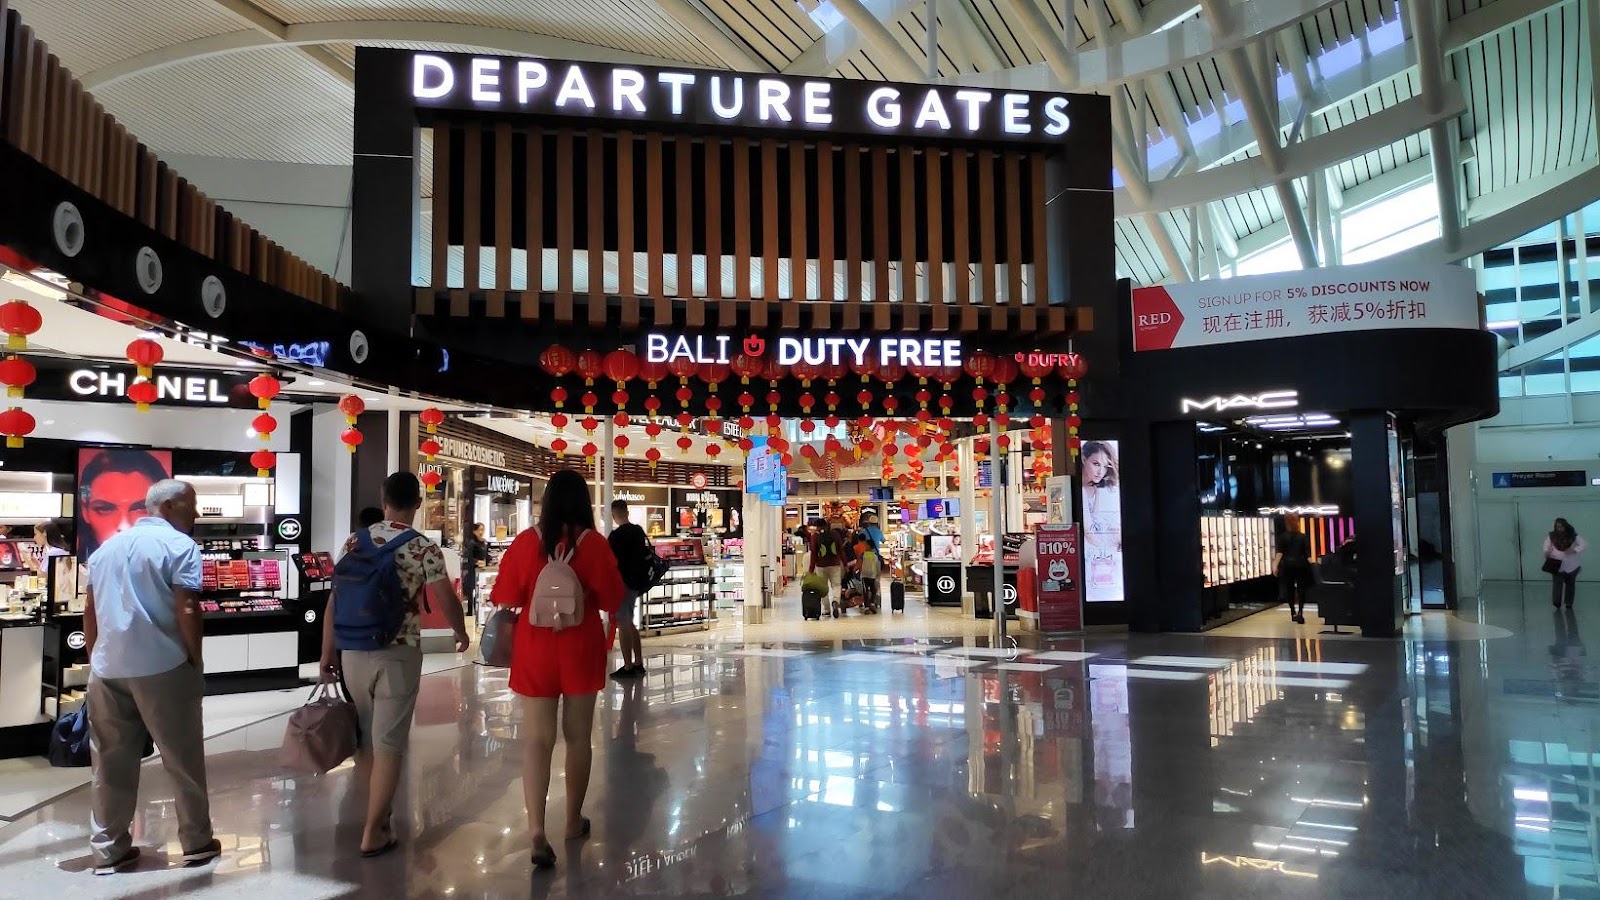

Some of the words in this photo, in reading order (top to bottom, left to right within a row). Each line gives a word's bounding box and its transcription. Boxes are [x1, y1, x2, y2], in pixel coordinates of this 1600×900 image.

[412, 54, 833, 124] DEPARTURE
[866, 87, 1071, 136] GATES
[1198, 295, 1230, 309] SIGN
[1233, 292, 1252, 305] UP
[1255, 289, 1282, 302] FOR
[1287, 287, 1308, 299] 5%
[1312, 281, 1396, 297] DISCOUNTS
[1400, 281, 1430, 292] NOW
[1139, 312, 1171, 327] RED
[647, 333, 731, 365] BALI
[778, 337, 871, 366] DUTY
[880, 338, 962, 367] FREE
[1028, 353, 1079, 367] DUFRY
[1046, 541, 1076, 555] 10%
